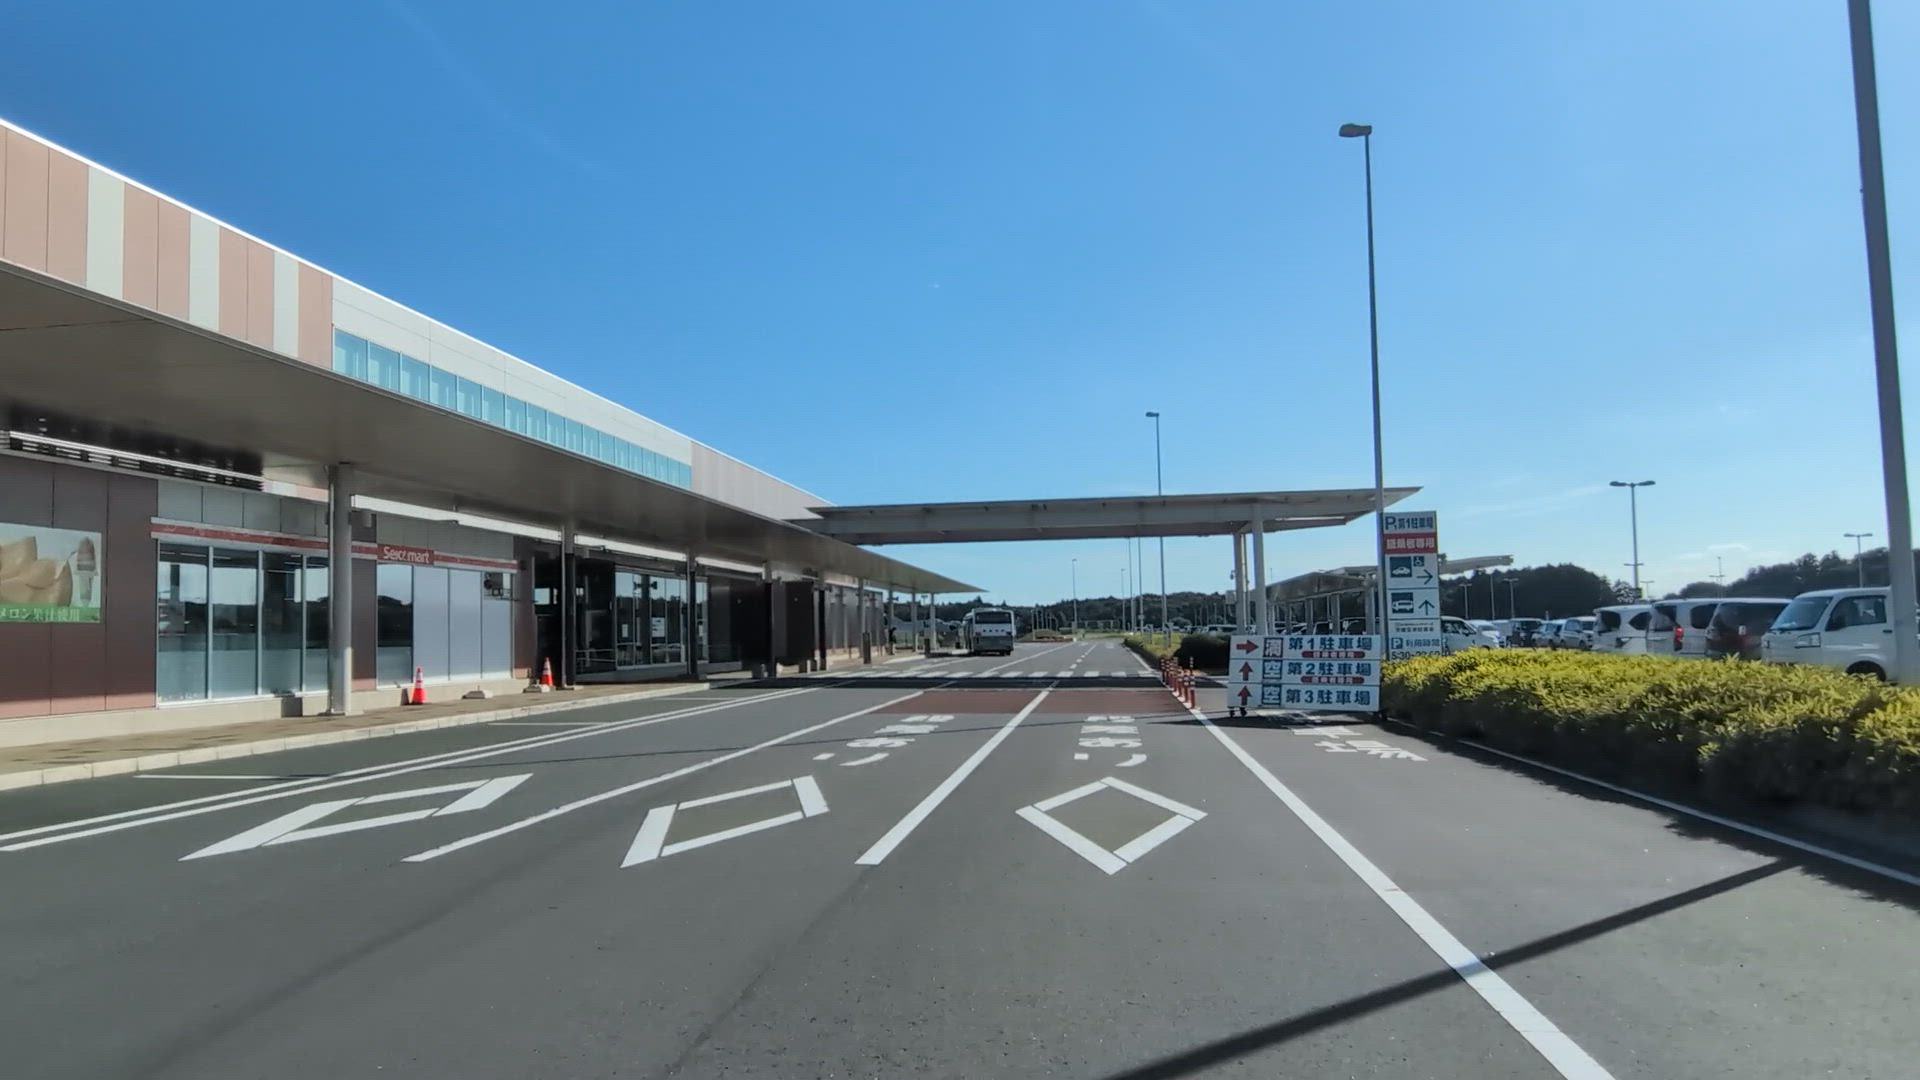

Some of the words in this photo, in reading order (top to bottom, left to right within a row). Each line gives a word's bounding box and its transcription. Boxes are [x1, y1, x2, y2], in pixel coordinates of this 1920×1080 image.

[1288, 637, 1373, 650] 第1駐車場
[1264, 661, 1281, 678] 空
[1287, 662, 1371, 676] 第2駐車場
[1263, 685, 1280, 703] 空
[1285, 689, 1370, 705] 第3駐車場
